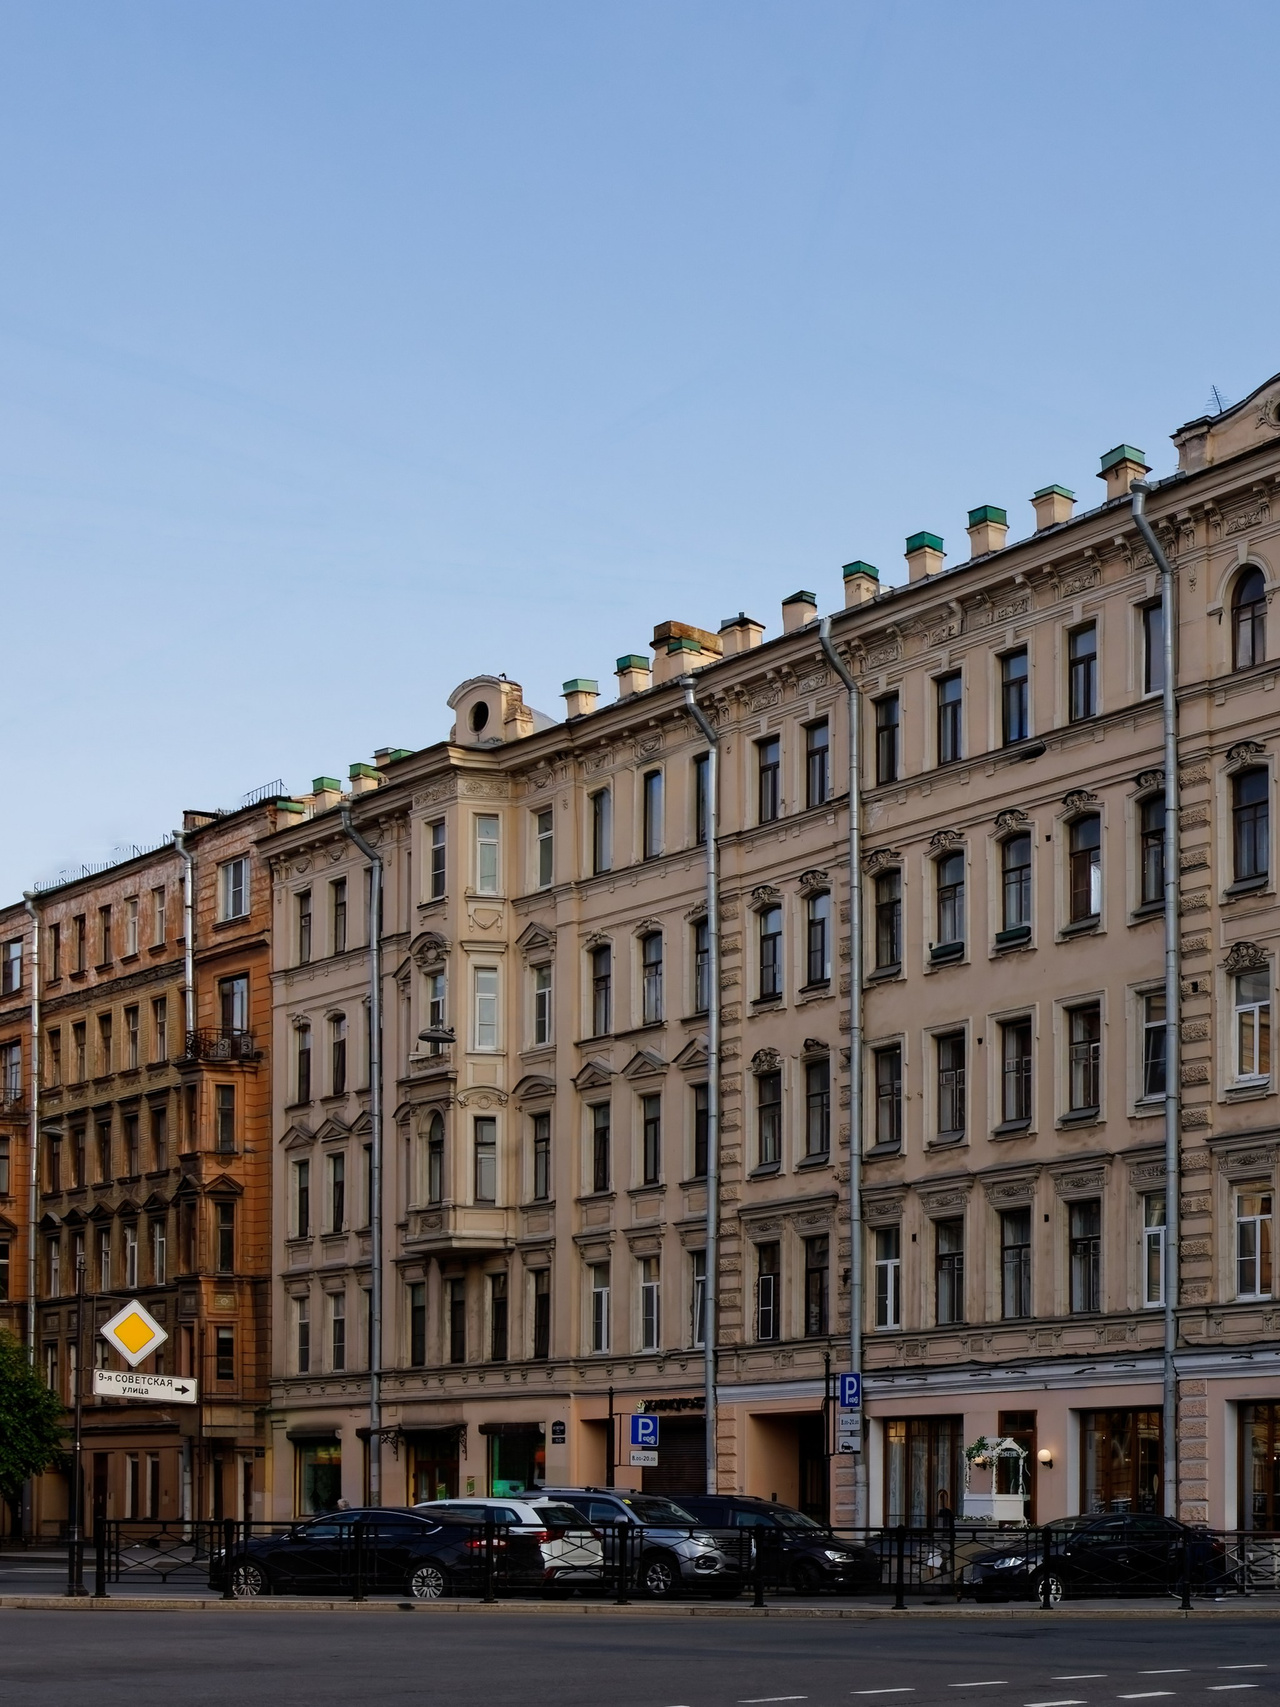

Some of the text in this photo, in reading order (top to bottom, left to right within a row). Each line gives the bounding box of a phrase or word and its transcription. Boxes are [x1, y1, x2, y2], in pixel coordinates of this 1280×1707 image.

[98, 1372, 173, 1387] 9-я СОВЕТСКАЯ
[121, 1386, 149, 1395] улица
[638, 1417, 654, 1442] P
